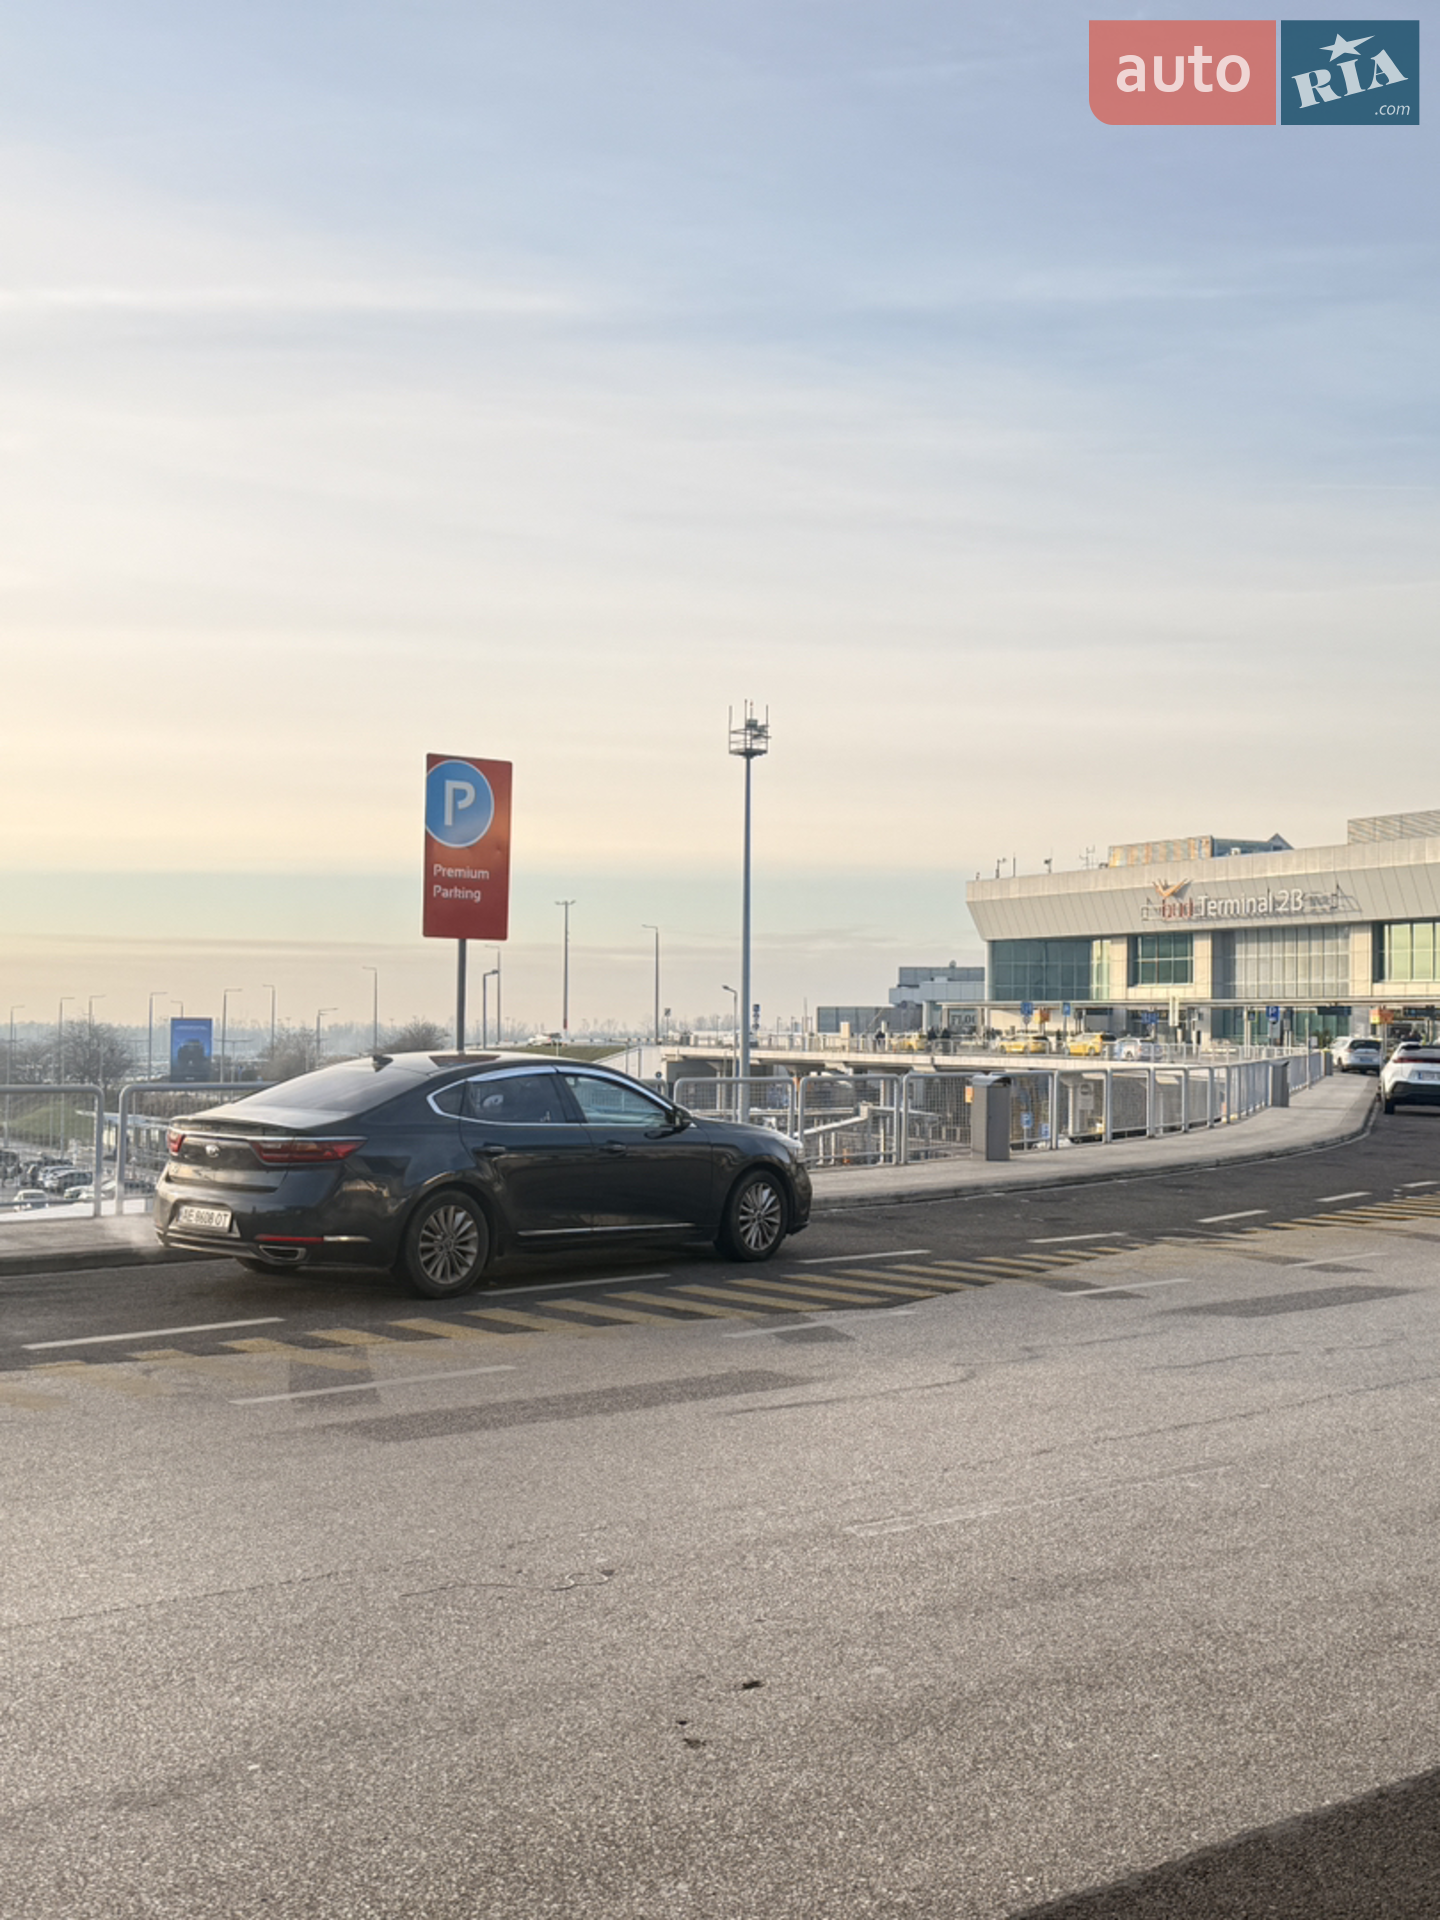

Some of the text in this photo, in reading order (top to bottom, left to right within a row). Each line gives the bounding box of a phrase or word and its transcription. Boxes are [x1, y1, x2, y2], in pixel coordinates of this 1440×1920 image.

[444, 780, 475, 826] P
[433, 864, 489, 879] Premium
[433, 885, 481, 902] Parking
[1197, 892, 1273, 916] Terminal
[1274, 889, 1304, 911] 2B
